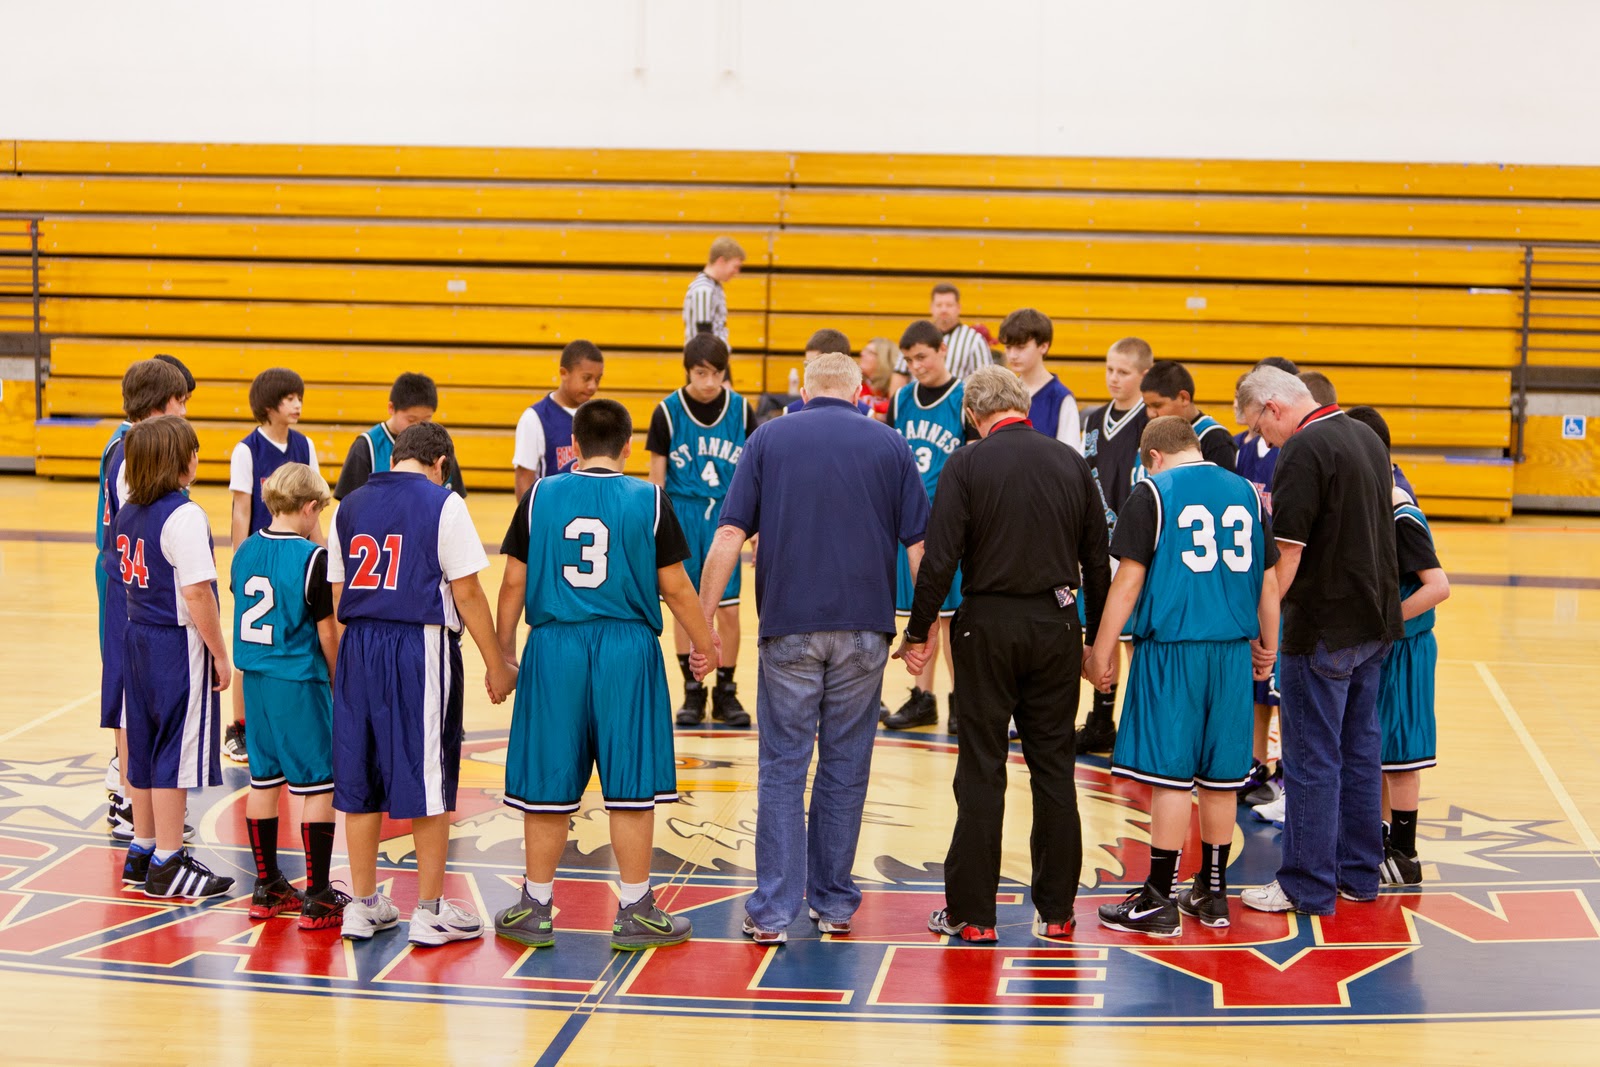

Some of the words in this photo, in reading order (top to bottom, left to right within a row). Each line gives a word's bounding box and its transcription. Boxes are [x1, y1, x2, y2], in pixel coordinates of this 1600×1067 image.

[669, 443, 693, 469] ST
[905, 419, 960, 454] ANNES
[909, 446, 933, 473] 3
[701, 460, 720, 487] 4
[116, 534, 149, 588] 34
[348, 533, 403, 591] 21
[562, 515, 610, 590] 3
[1177, 504, 1253, 573] 33
[240, 575, 276, 647] 2
